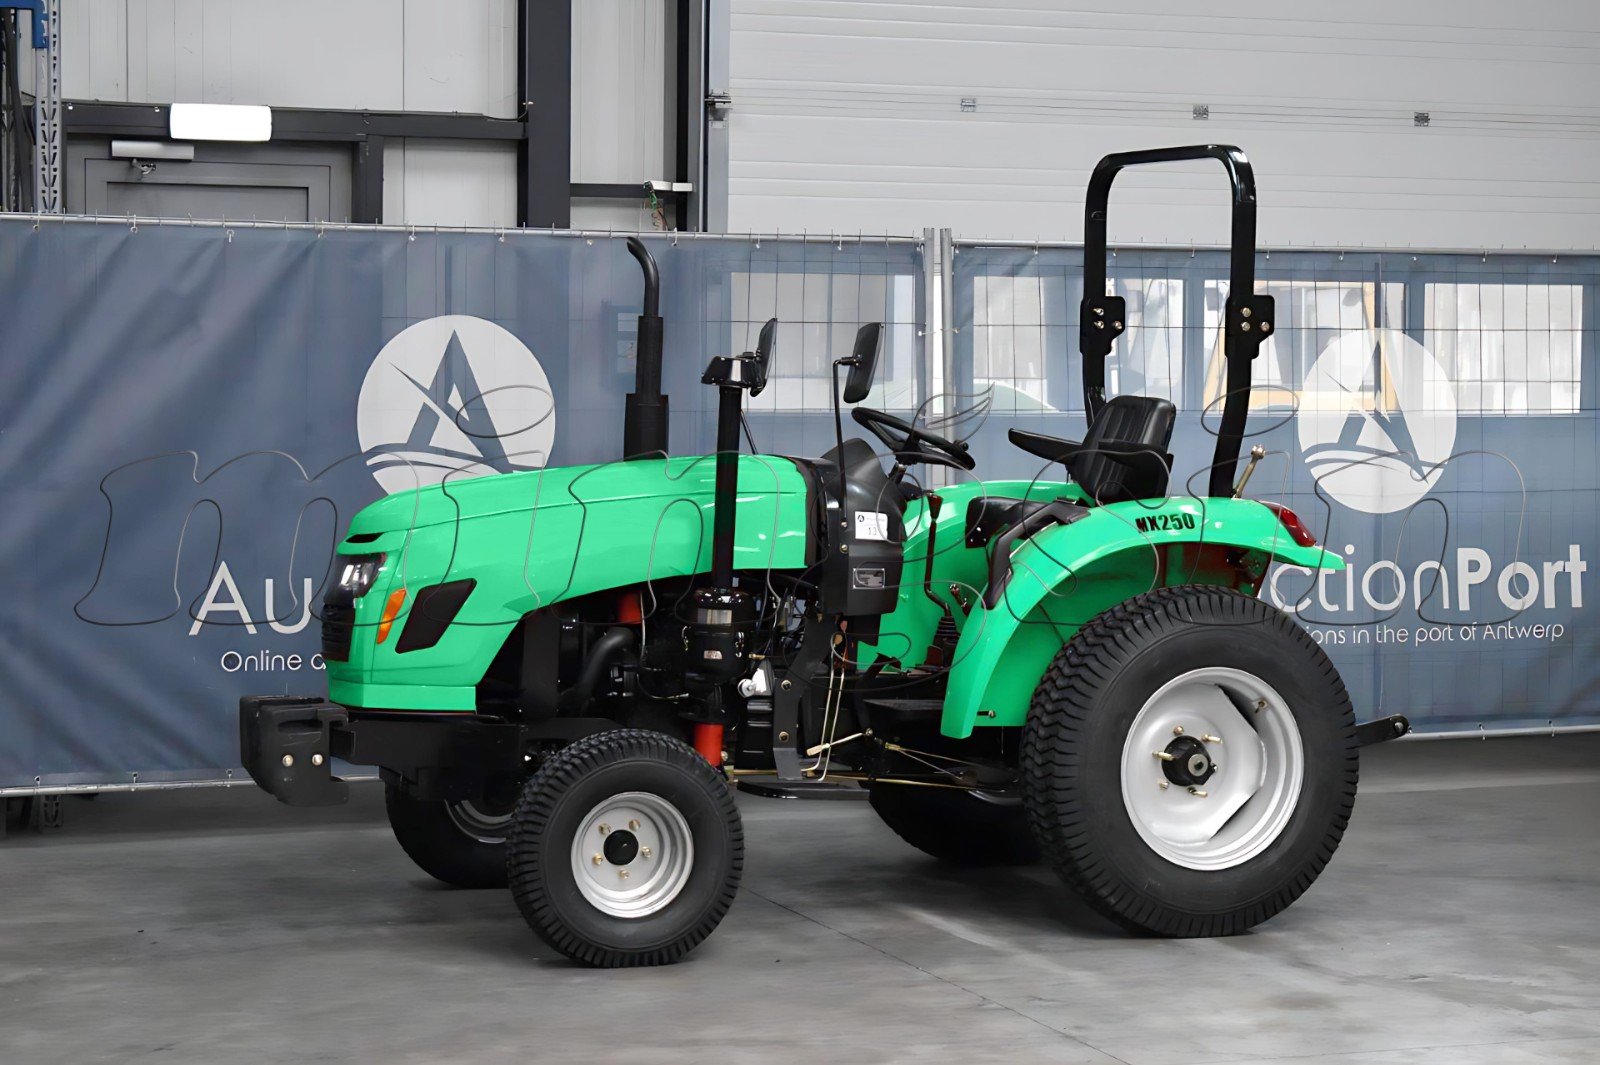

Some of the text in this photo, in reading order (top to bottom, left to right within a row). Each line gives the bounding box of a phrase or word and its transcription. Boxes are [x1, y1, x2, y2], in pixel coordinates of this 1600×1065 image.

[1352, 625, 1370, 645] in
[1375, 624, 1409, 644] the
[1415, 624, 1453, 647] port
[1460, 622, 1479, 642] of
[1483, 621, 1564, 642] Antwerp
[220, 650, 302, 673] Online
